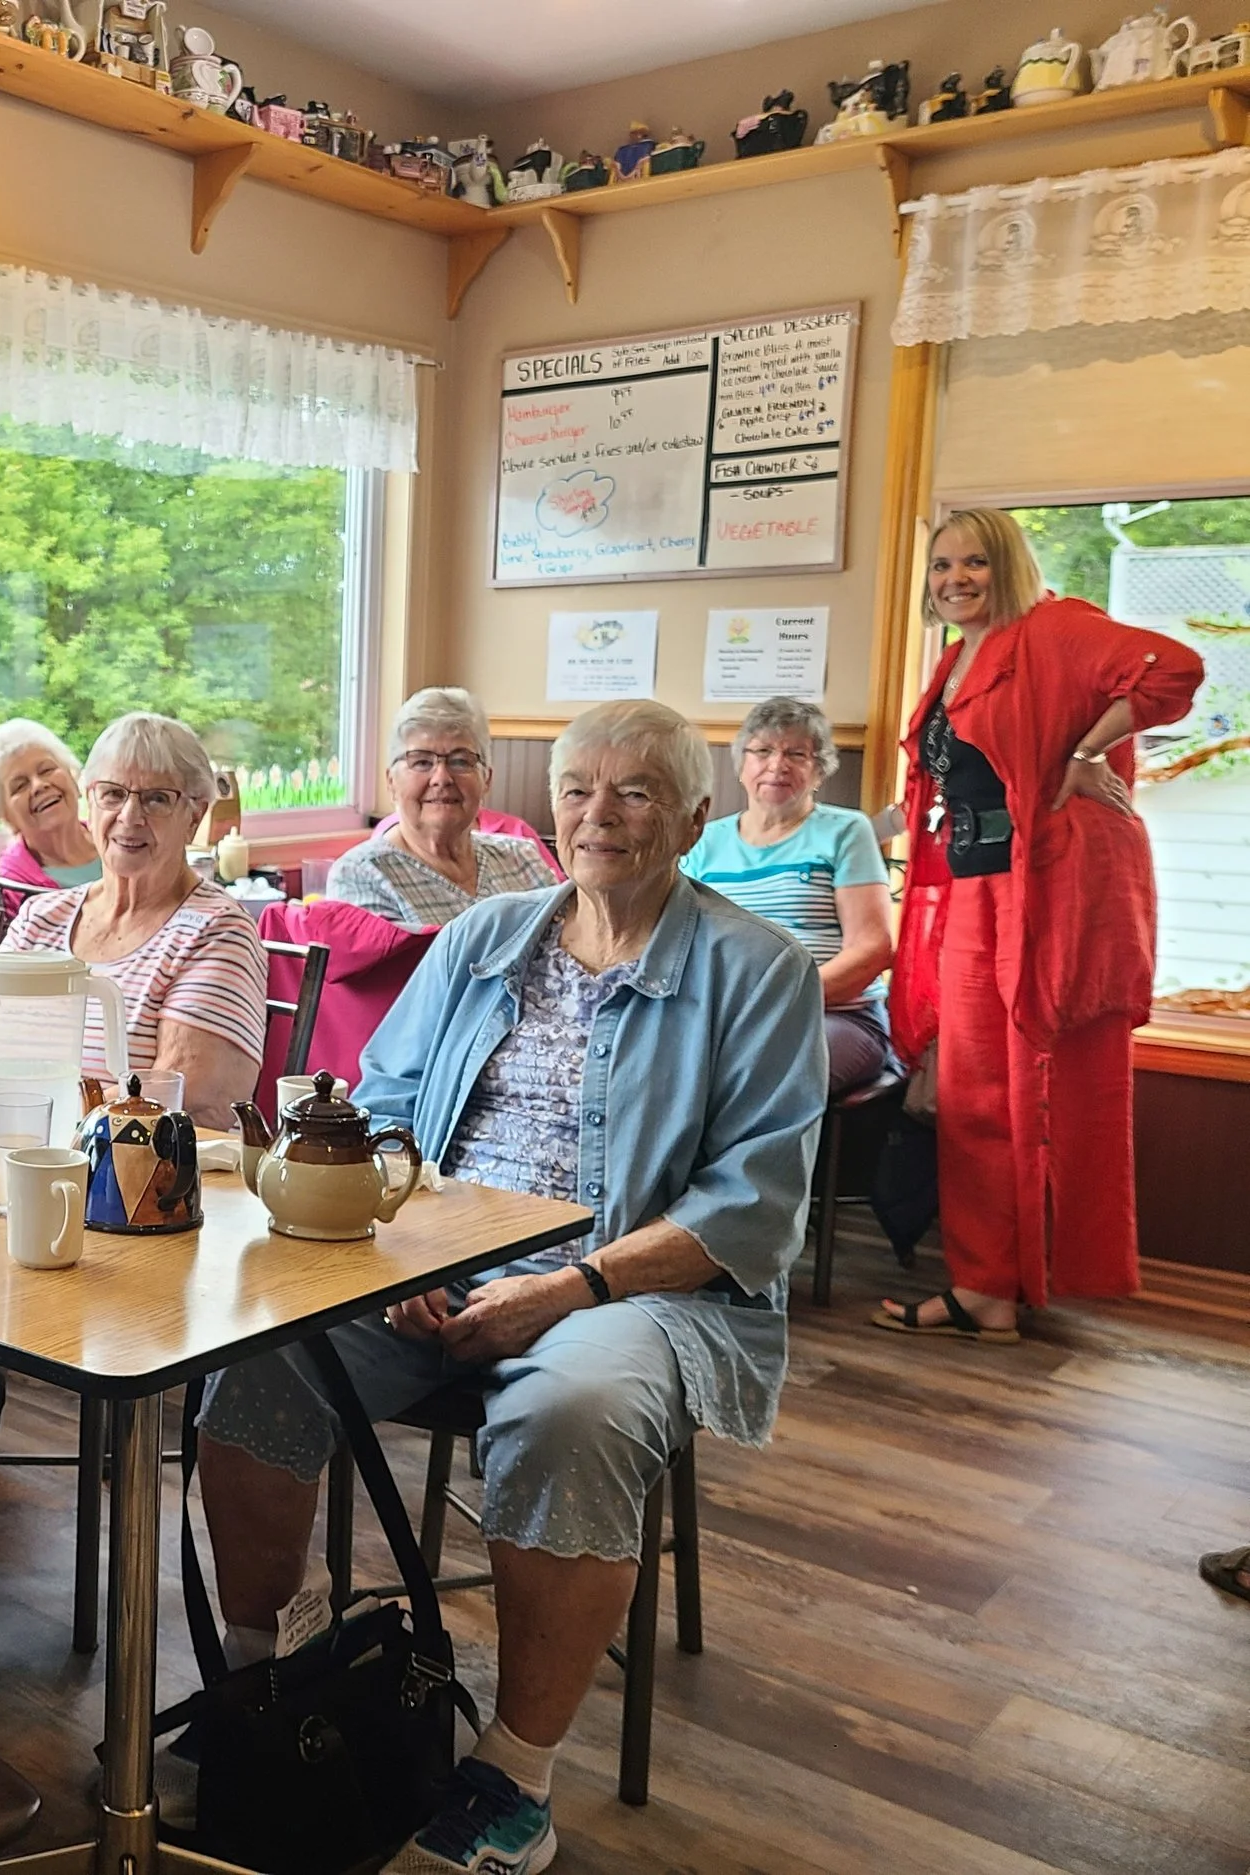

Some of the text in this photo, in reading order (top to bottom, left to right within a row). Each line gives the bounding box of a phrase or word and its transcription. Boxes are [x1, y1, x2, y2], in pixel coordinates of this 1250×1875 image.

[517, 352, 603, 382] SPECIALS
[507, 403, 572, 424] Hamburger
[717, 516, 819, 542] VEGETABLE
